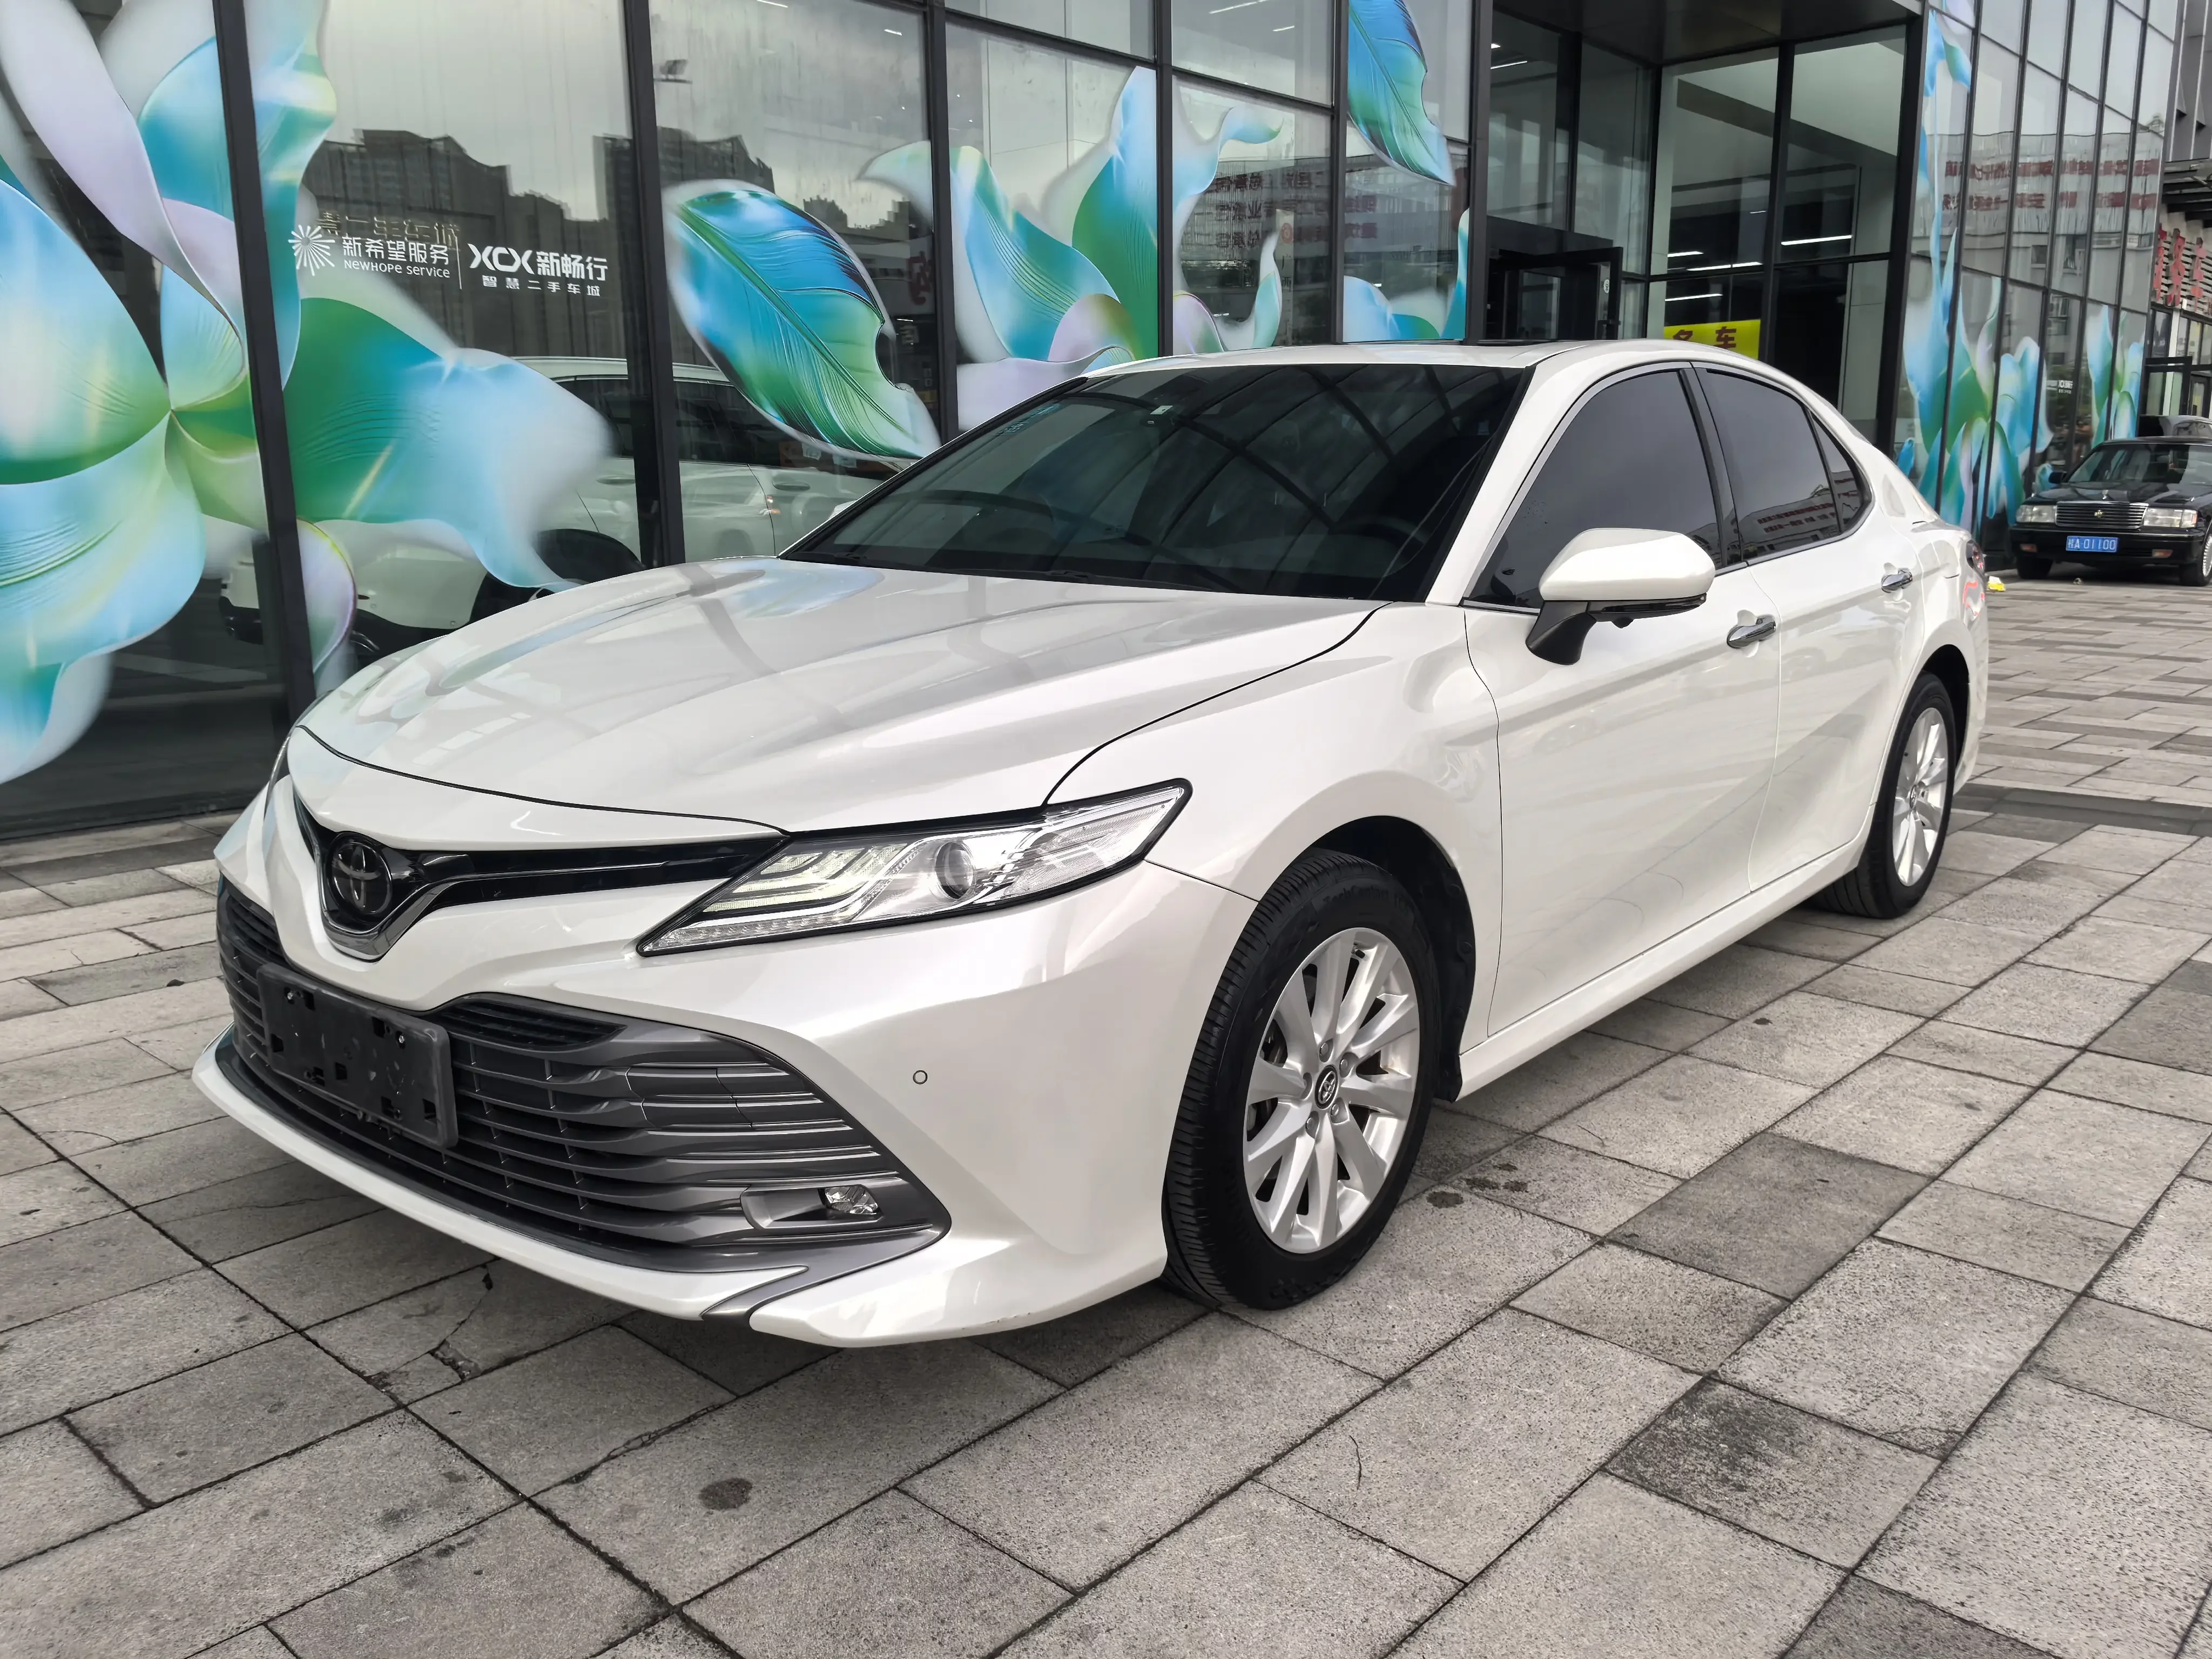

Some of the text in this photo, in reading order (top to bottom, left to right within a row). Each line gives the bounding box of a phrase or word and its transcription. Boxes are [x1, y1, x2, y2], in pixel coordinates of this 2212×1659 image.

[342, 233, 449, 265] 新希望服务
[406, 265, 450, 278] service
[536, 251, 609, 281] 新畅行
[482, 275, 601, 296] 智慧二手车城
